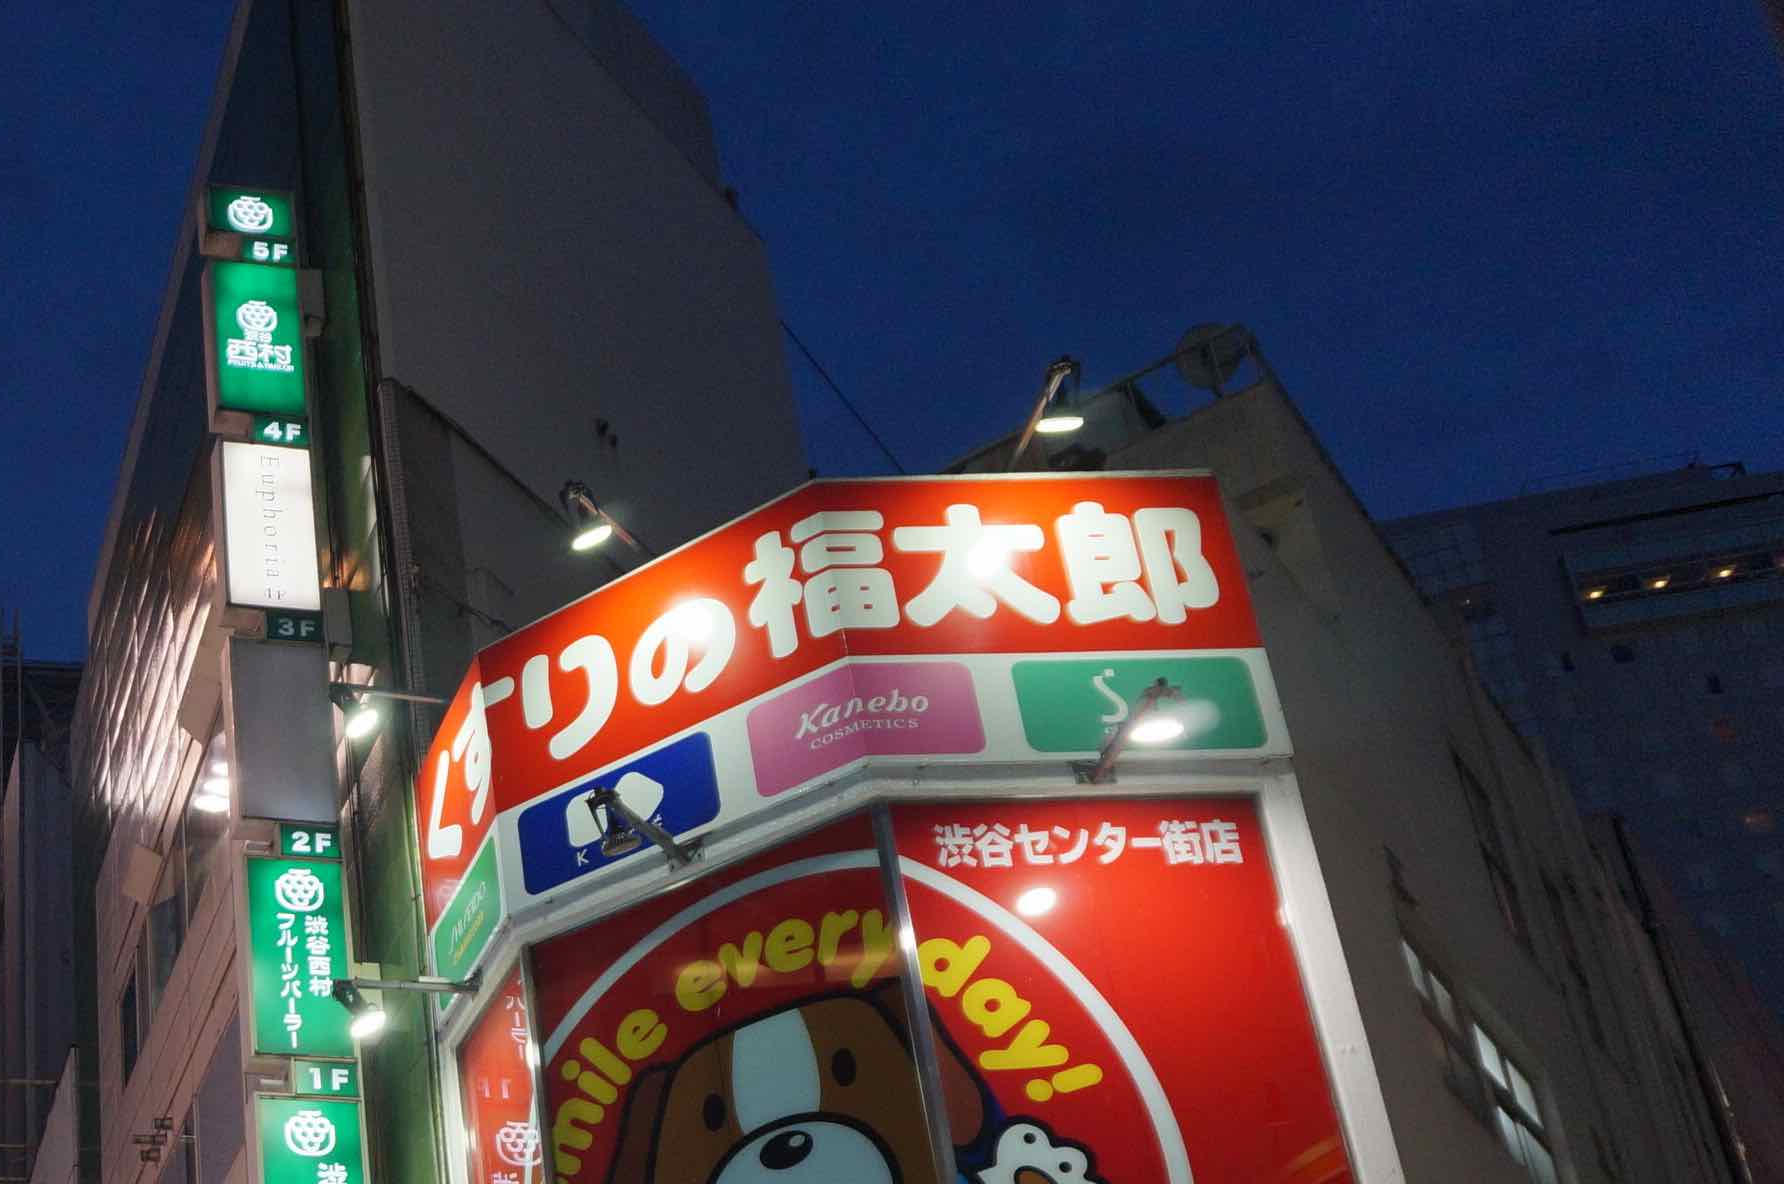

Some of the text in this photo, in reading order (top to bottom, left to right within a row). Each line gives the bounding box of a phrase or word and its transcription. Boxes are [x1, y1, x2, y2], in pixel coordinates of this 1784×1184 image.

[252, 240, 289, 262] 5F
[263, 421, 303, 441] 4F
[277, 616, 318, 637] 3F
[428, 501, 1220, 860] くすりの福太郎
[794, 689, 930, 741] Kanebo
[810, 718, 921, 752] COSMETICS
[291, 831, 332, 854] 2F
[934, 818, 1244, 870] 渋谷センター街店
[303, 914, 334, 998] 渋谷西村
[274, 912, 305, 1050] フルーツパーラー
[674, 909, 902, 1012] every
[916, 934, 1104, 1103] day!
[308, 1066, 350, 1093] 1F
